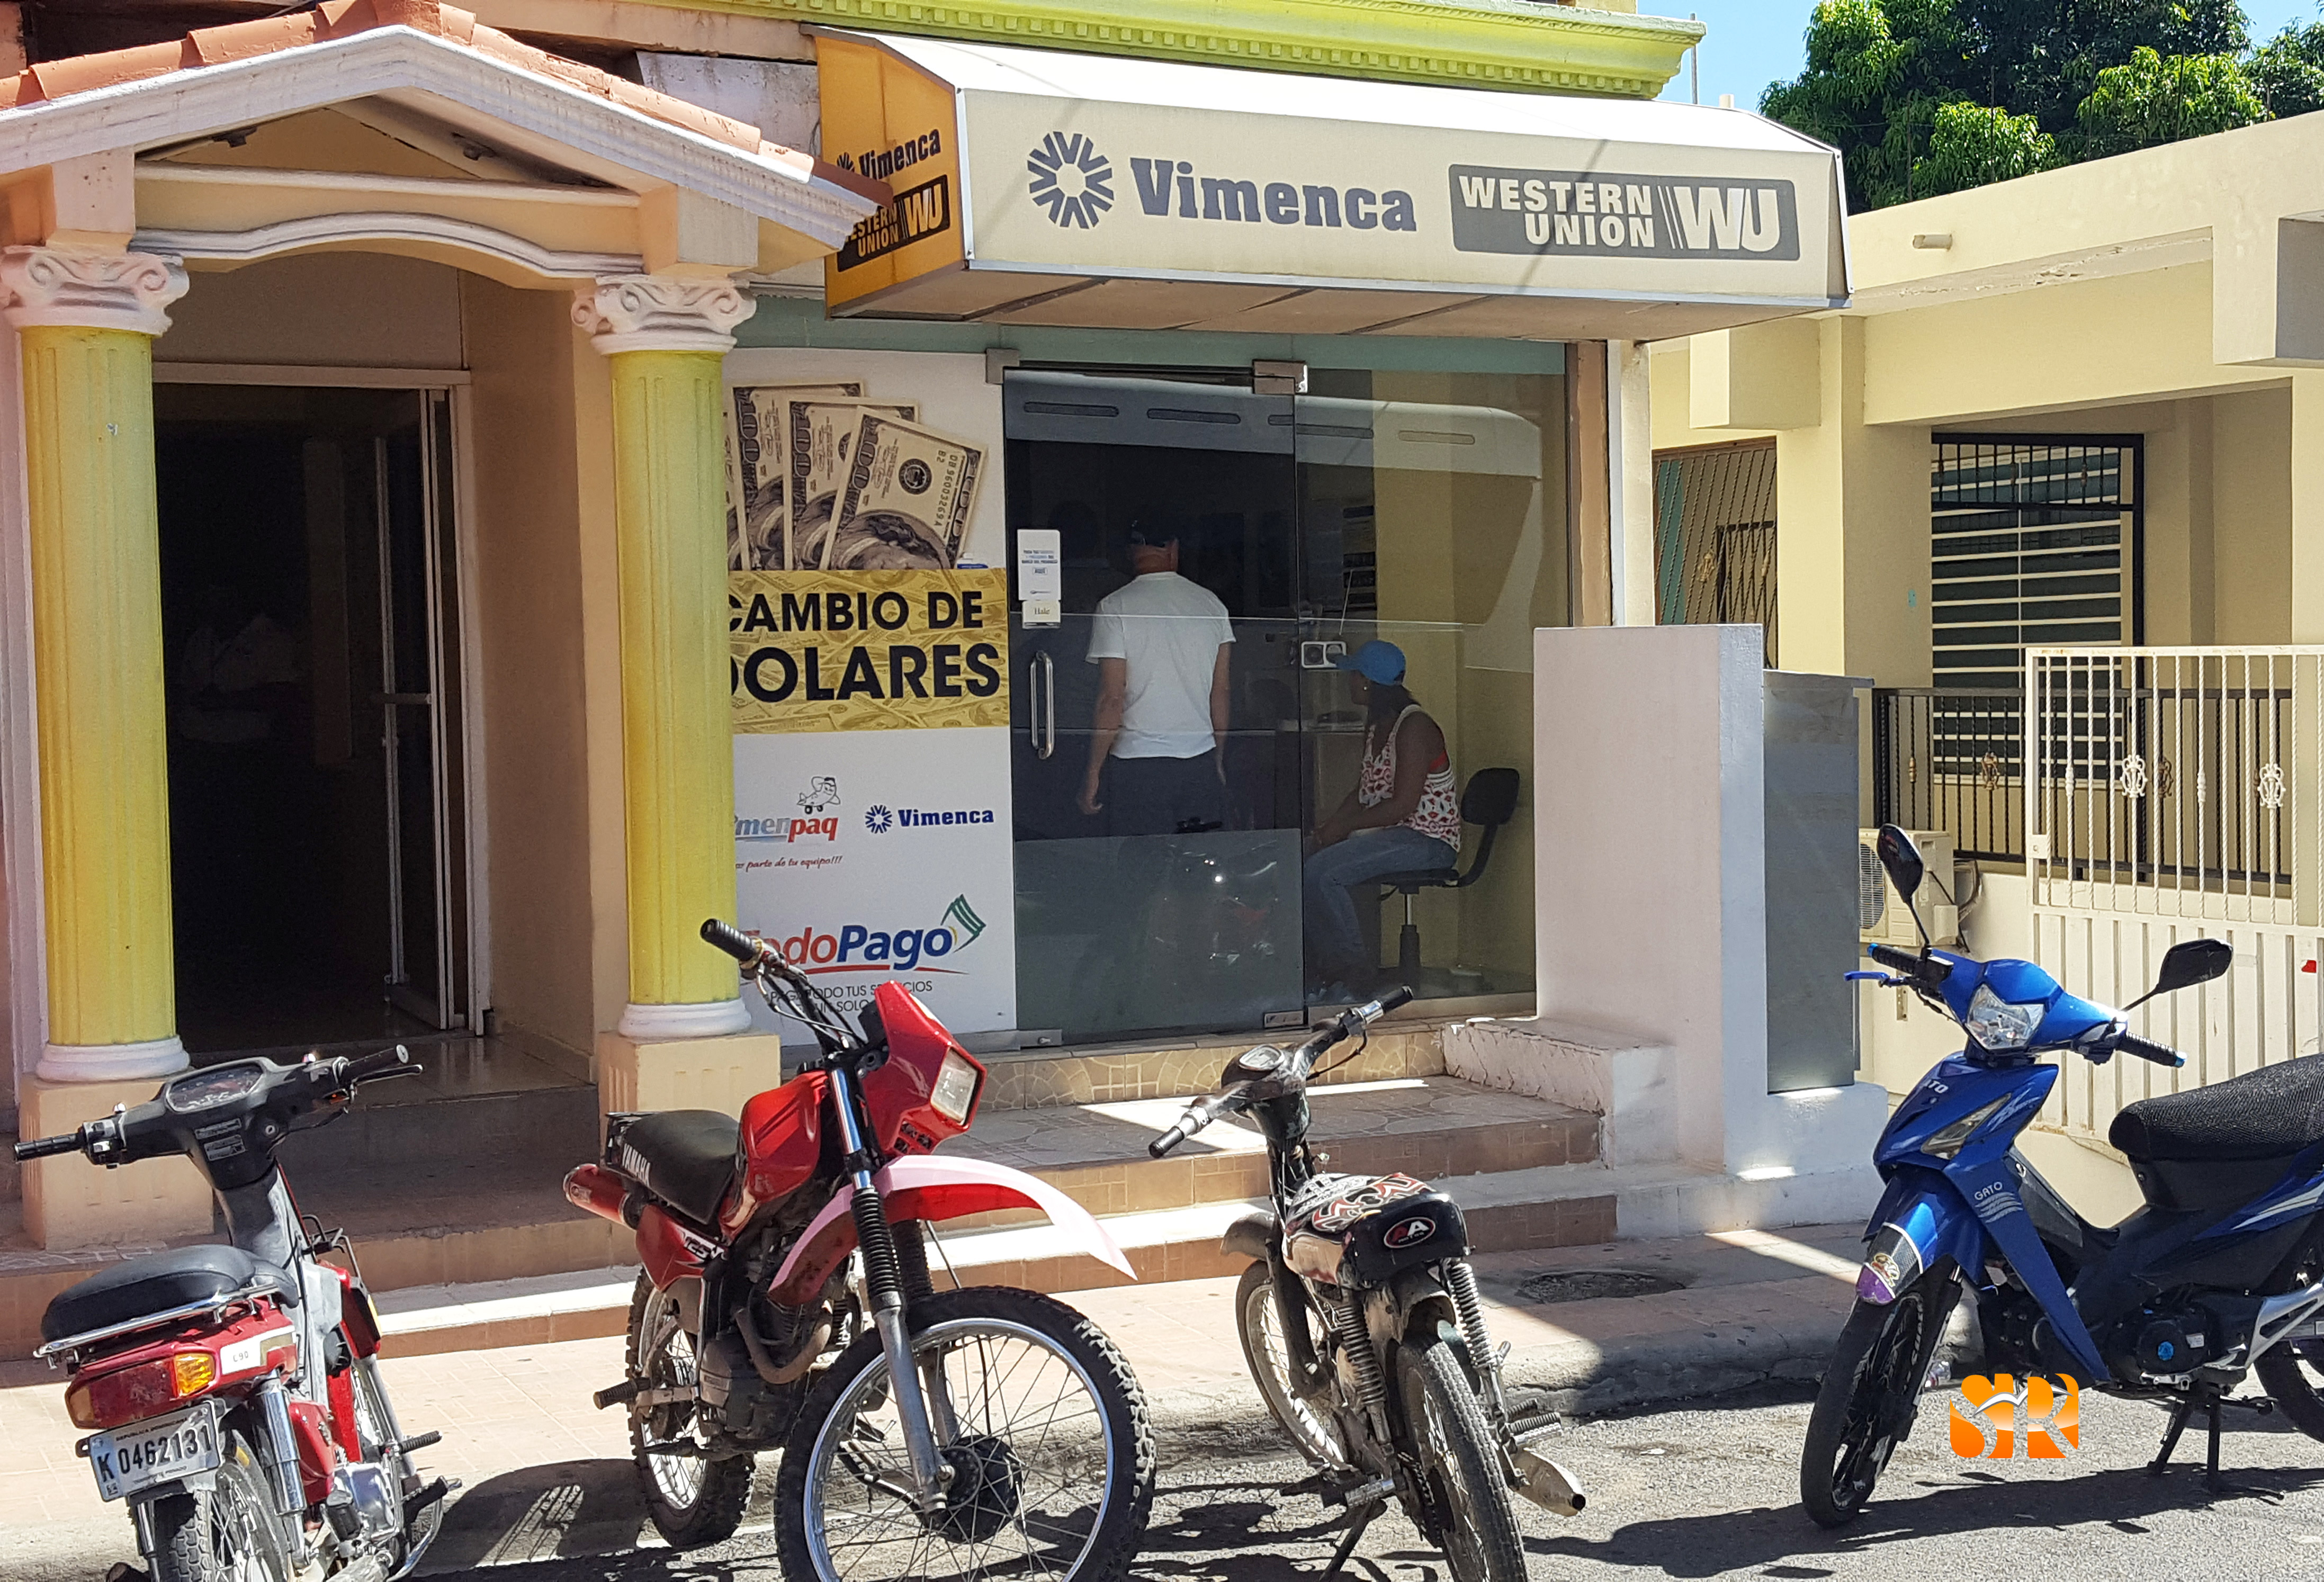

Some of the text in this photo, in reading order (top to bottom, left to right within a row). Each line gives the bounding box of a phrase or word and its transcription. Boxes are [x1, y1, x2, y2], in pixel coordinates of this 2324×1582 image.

[858, 129, 941, 181] Vimenca
[903, 184, 943, 237] WU
[1129, 157, 1417, 231] Vimenca
[1458, 175, 1653, 215] WESTERN
[1524, 212, 1655, 249] UNION
[1673, 186, 1780, 252] WU
[857, 223, 899, 258] UNION
[928, 591, 983, 630] DE
[730, 643, 1001, 703] OLARES
[898, 808, 994, 827] Vimenca
[746, 859, 773, 873] parte
[788, 857, 797, 867] tu
[846, 985, 867, 997] TUS
[622, 1143, 651, 1187] YAMAHA
[1974, 1181, 2003, 1201] GATO
